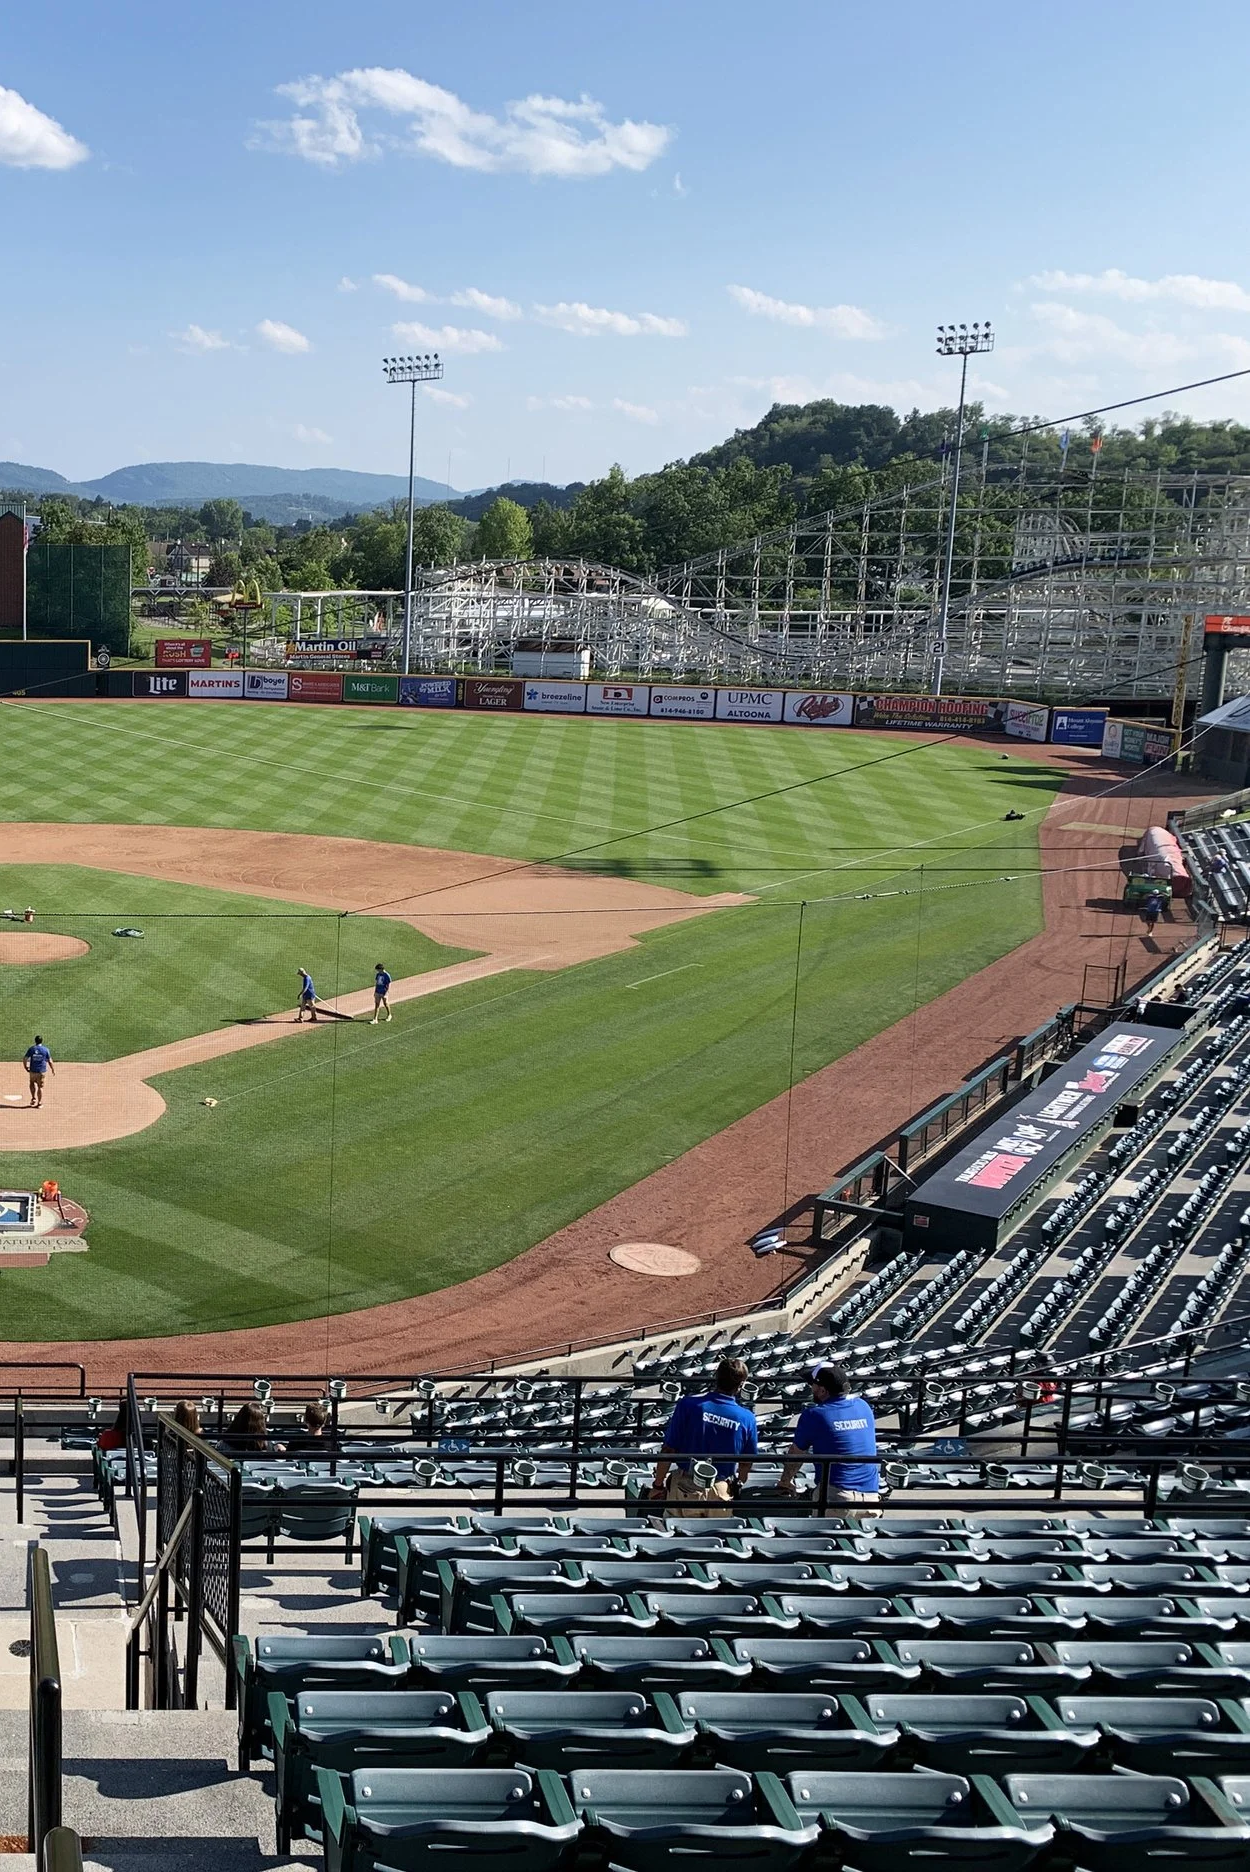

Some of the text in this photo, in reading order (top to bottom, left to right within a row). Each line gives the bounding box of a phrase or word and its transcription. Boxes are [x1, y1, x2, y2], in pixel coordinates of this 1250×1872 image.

[295, 641, 356, 651] Martin Oil
[148, 676, 178, 694] Lite
[190, 680, 240, 688] MARTIN'S
[263, 676, 286, 685] boyer
[351, 682, 390, 692] M&T Bank
[427, 685, 451, 694] MILK
[474, 681, 514, 695] Yuengling
[479, 697, 507, 706] LAGER
[541, 692, 582, 701] breezeline
[728, 692, 773, 705] UPMC
[876, 699, 990, 716] CHAMPION ROOFING
[727, 709, 772, 719] ALTOONA
[885, 719, 974, 729] LIFETIME WARRANTY
[1146, 732, 1170, 745] MAJOR
[54, 1238, 85, 1246] GAS
[702, 1412, 741, 1432] SECURITY
[833, 1418, 869, 1432] SECURITY
